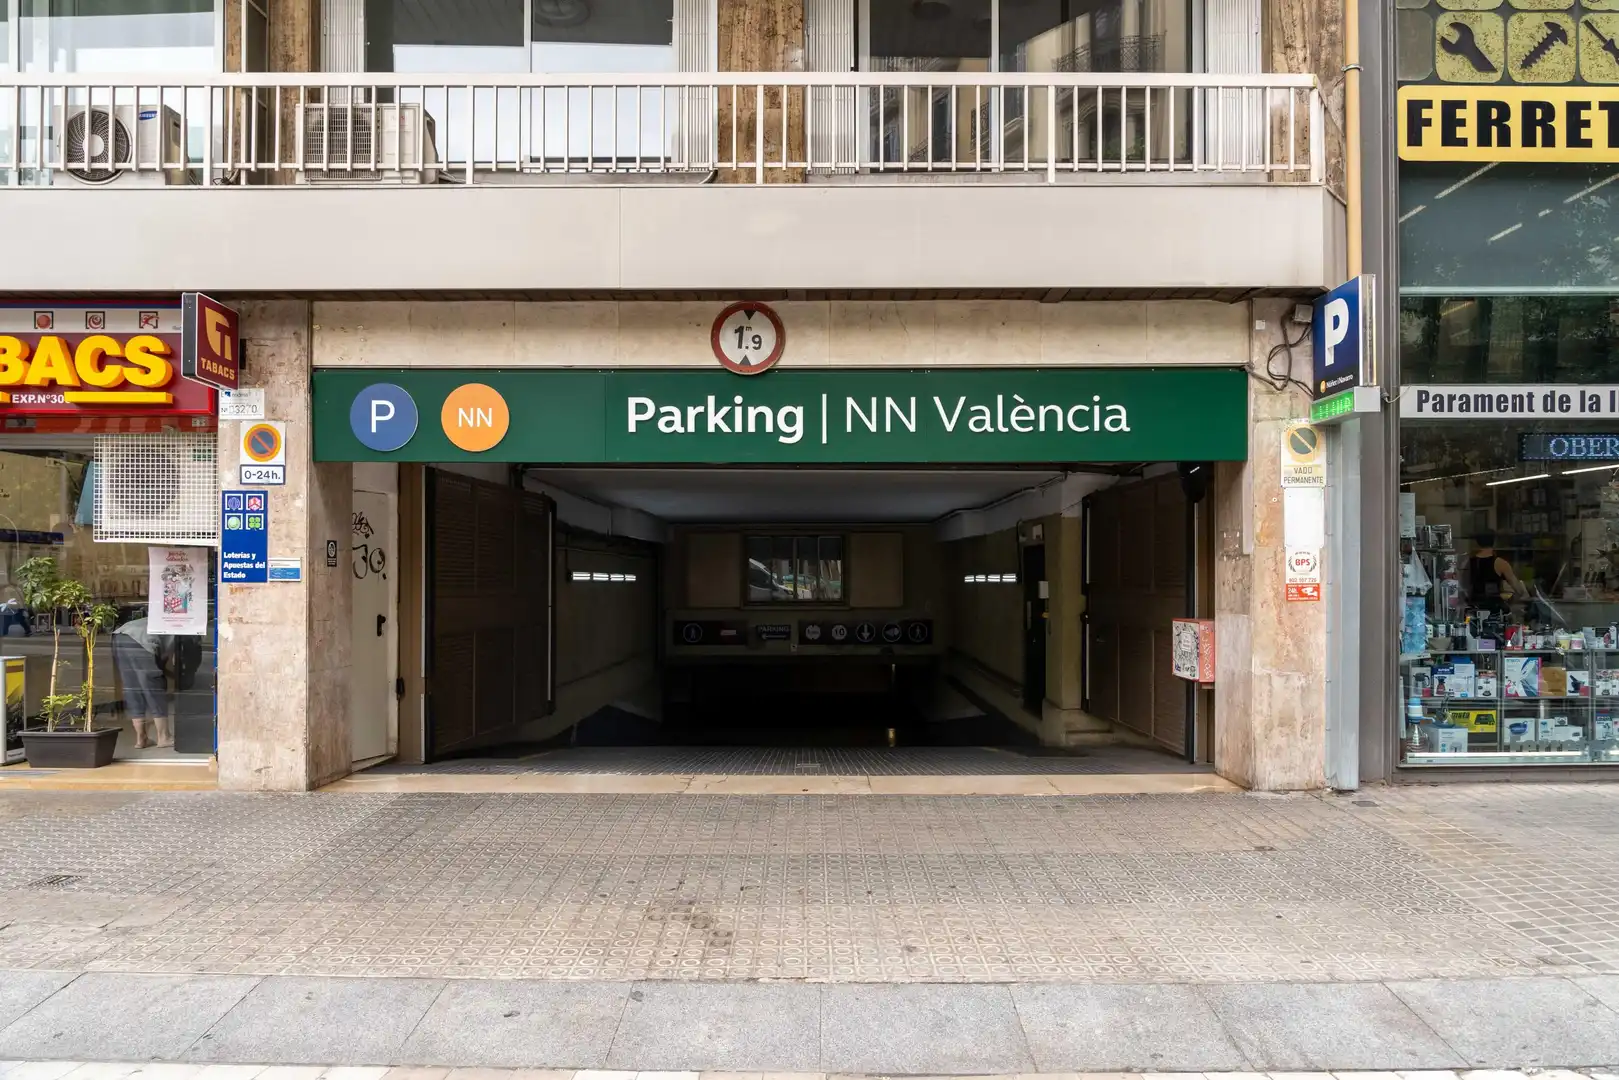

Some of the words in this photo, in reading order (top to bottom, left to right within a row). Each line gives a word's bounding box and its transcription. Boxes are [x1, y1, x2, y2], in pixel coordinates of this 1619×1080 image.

[1407, 100, 1619, 148] FERRET
[1324, 298, 1349, 366] P
[200, 357, 235, 380] TABACS
[1417, 390, 1535, 413] Parament
[1543, 390, 1572, 413] de
[1580, 390, 1600, 413] la
[371, 400, 395, 433] P
[458, 408, 492, 427] NN
[628, 395, 803, 444] Parking
[846, 397, 916, 433] NN
[932, 394, 1130, 433] València
[1294, 466, 1312, 474] VADO
[223, 562, 253, 570] Apuestas
[255, 561, 266, 569] del
[251, 552, 256, 560] y
[223, 571, 246, 579] Estado
[758, 625, 790, 633] PARKING
